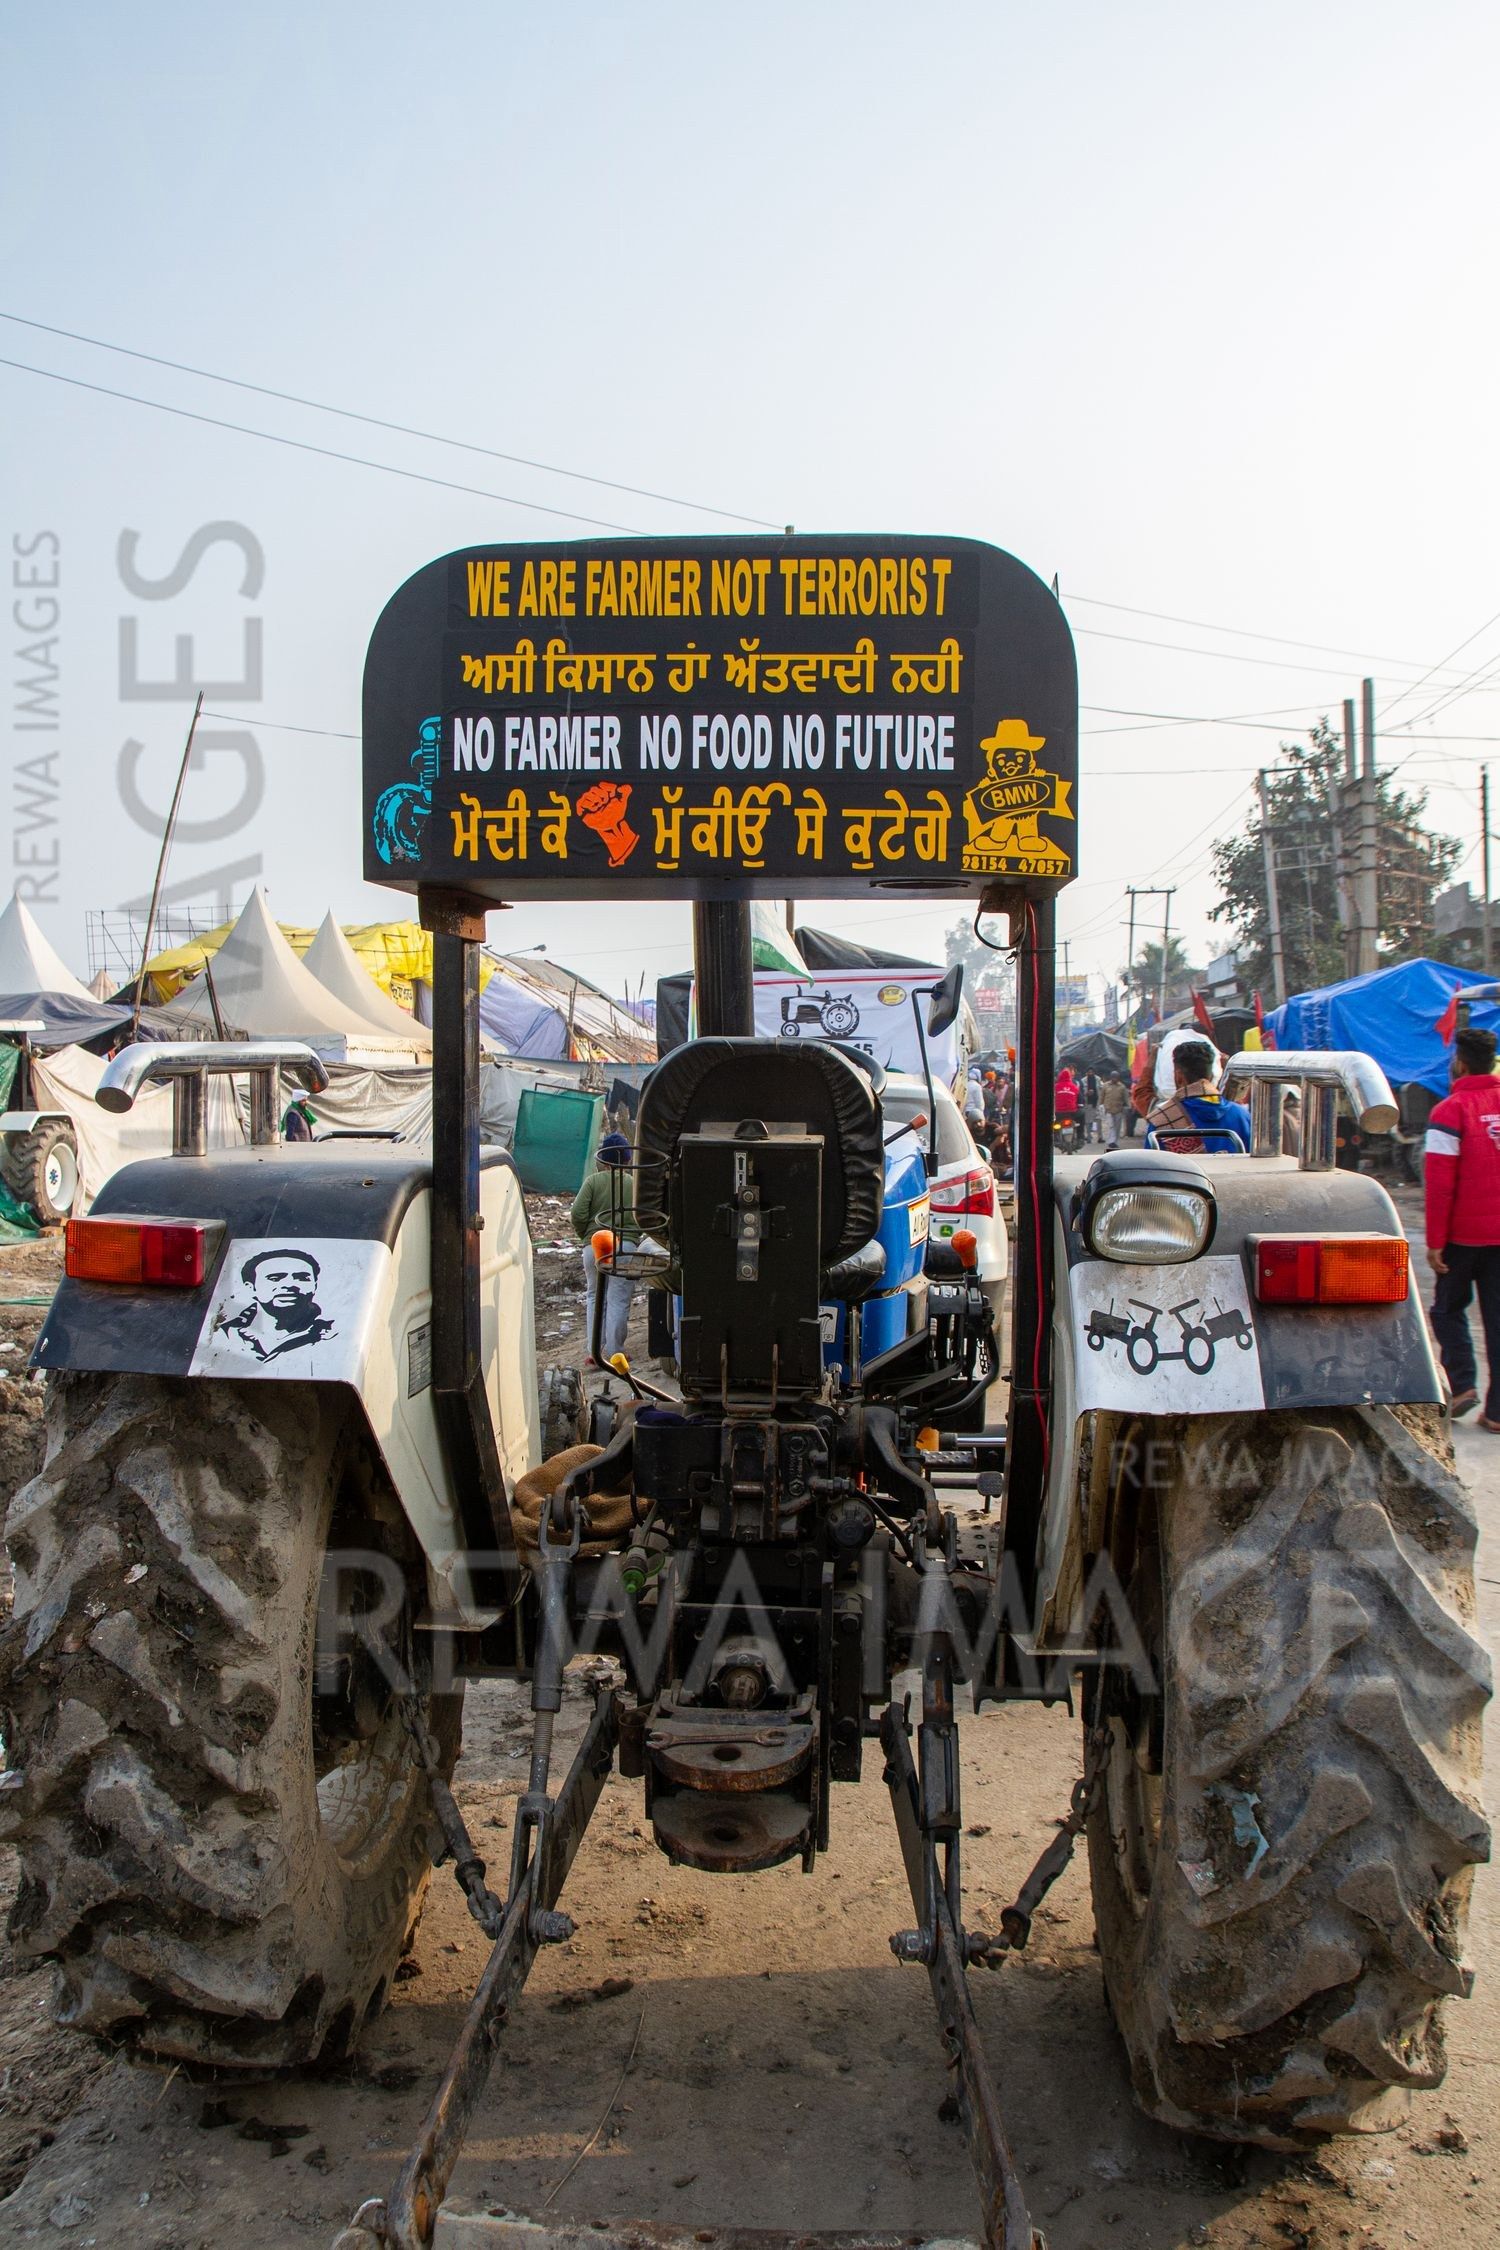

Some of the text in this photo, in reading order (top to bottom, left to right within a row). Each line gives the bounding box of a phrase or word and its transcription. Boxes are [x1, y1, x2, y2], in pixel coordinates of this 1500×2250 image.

[467, 557, 952, 617] WE ARE FARMER NOT TERRORIST
[460, 638, 538, 694] ਅਸੀ
[541, 638, 657, 694] ਕਿਸਾਨ
[666, 642, 712, 693] ਹਾਂ
[453, 713, 955, 772] NO FARMER NO FOOD NO FUTURE
[990, 783, 1038, 809] BMW
[961, 855, 1065, 875] 98154 47057
